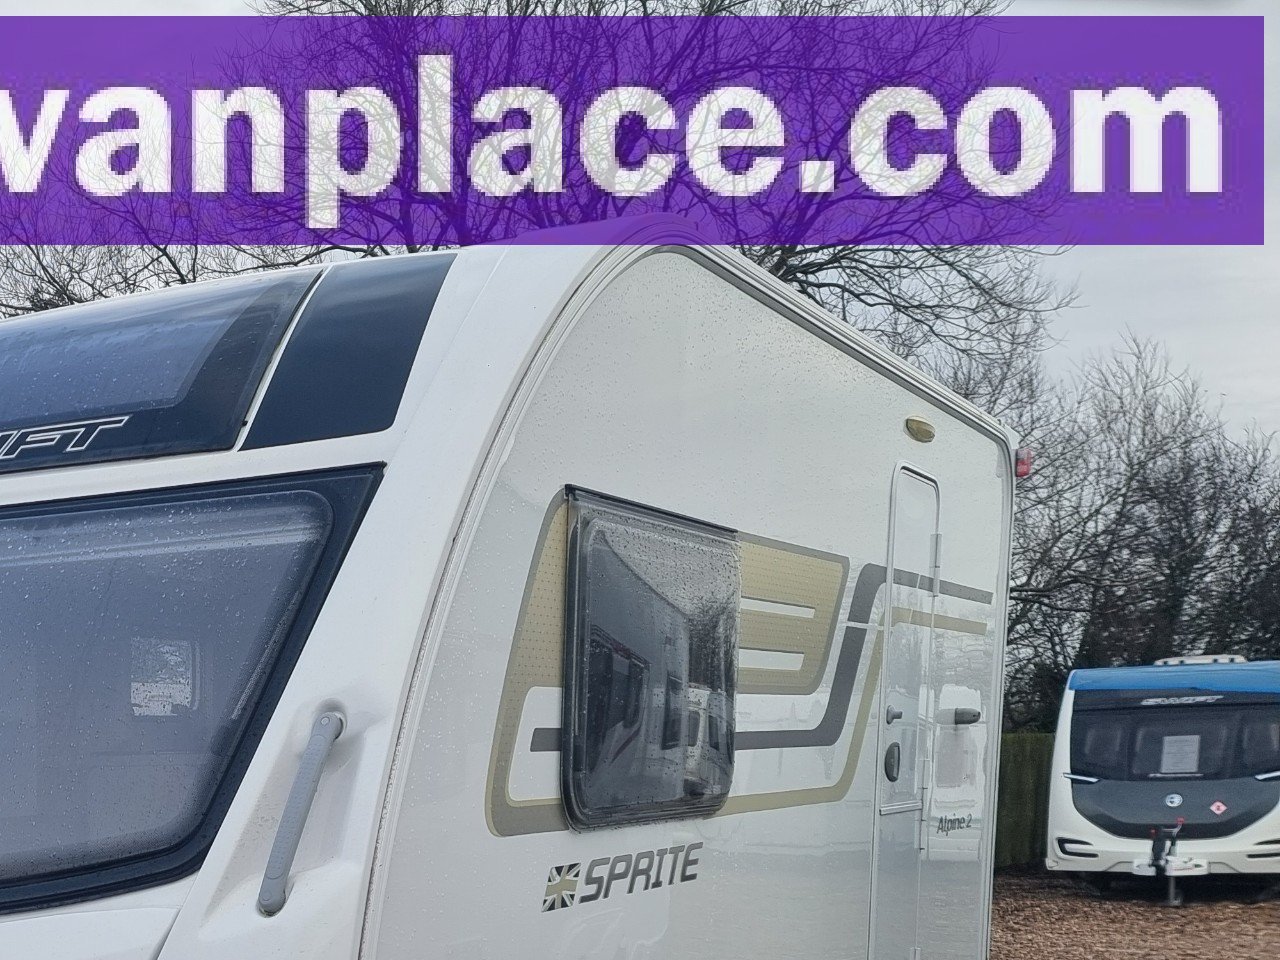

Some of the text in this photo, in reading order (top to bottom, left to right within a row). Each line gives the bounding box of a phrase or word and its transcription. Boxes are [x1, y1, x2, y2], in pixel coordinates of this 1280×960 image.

[936, 813, 973, 837] Alpine 2
[579, 841, 704, 905] SPRITE
